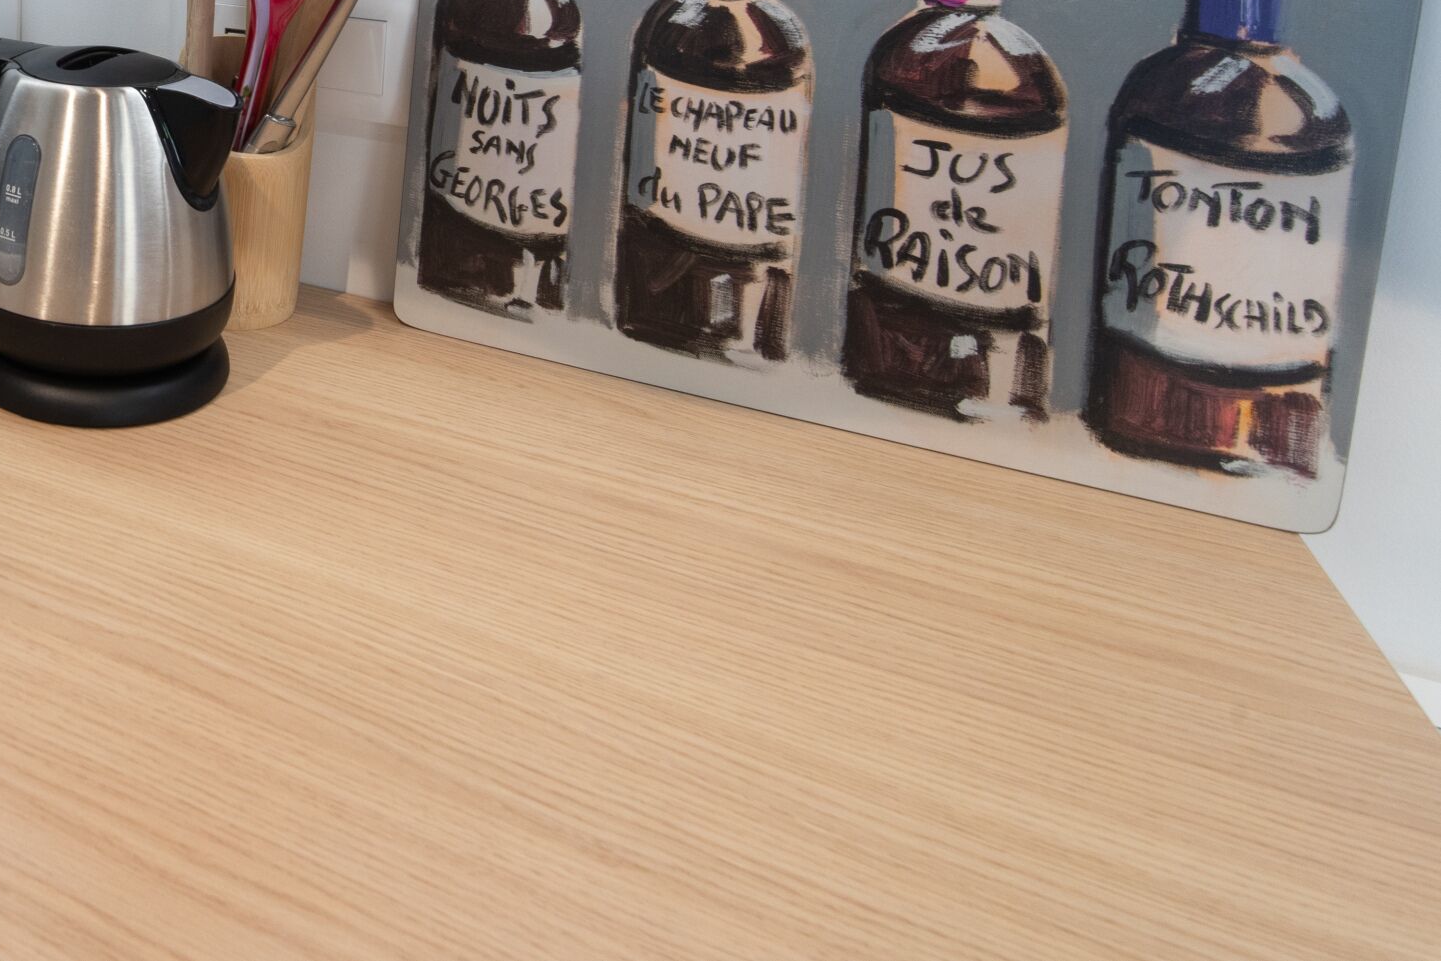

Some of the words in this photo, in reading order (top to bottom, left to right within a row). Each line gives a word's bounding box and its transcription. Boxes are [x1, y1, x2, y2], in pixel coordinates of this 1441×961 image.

[638, 82, 666, 115] LE
[670, 95, 799, 134] CHAPEAU
[468, 129, 539, 175] SANS
[668, 134, 763, 172] NEUF
[899, 139, 1018, 194] JUS
[429, 150, 568, 228] GEORGES
[697, 182, 796, 236] PAPE
[930, 187, 1003, 233] de
[1124, 169, 1321, 245] TONTON
